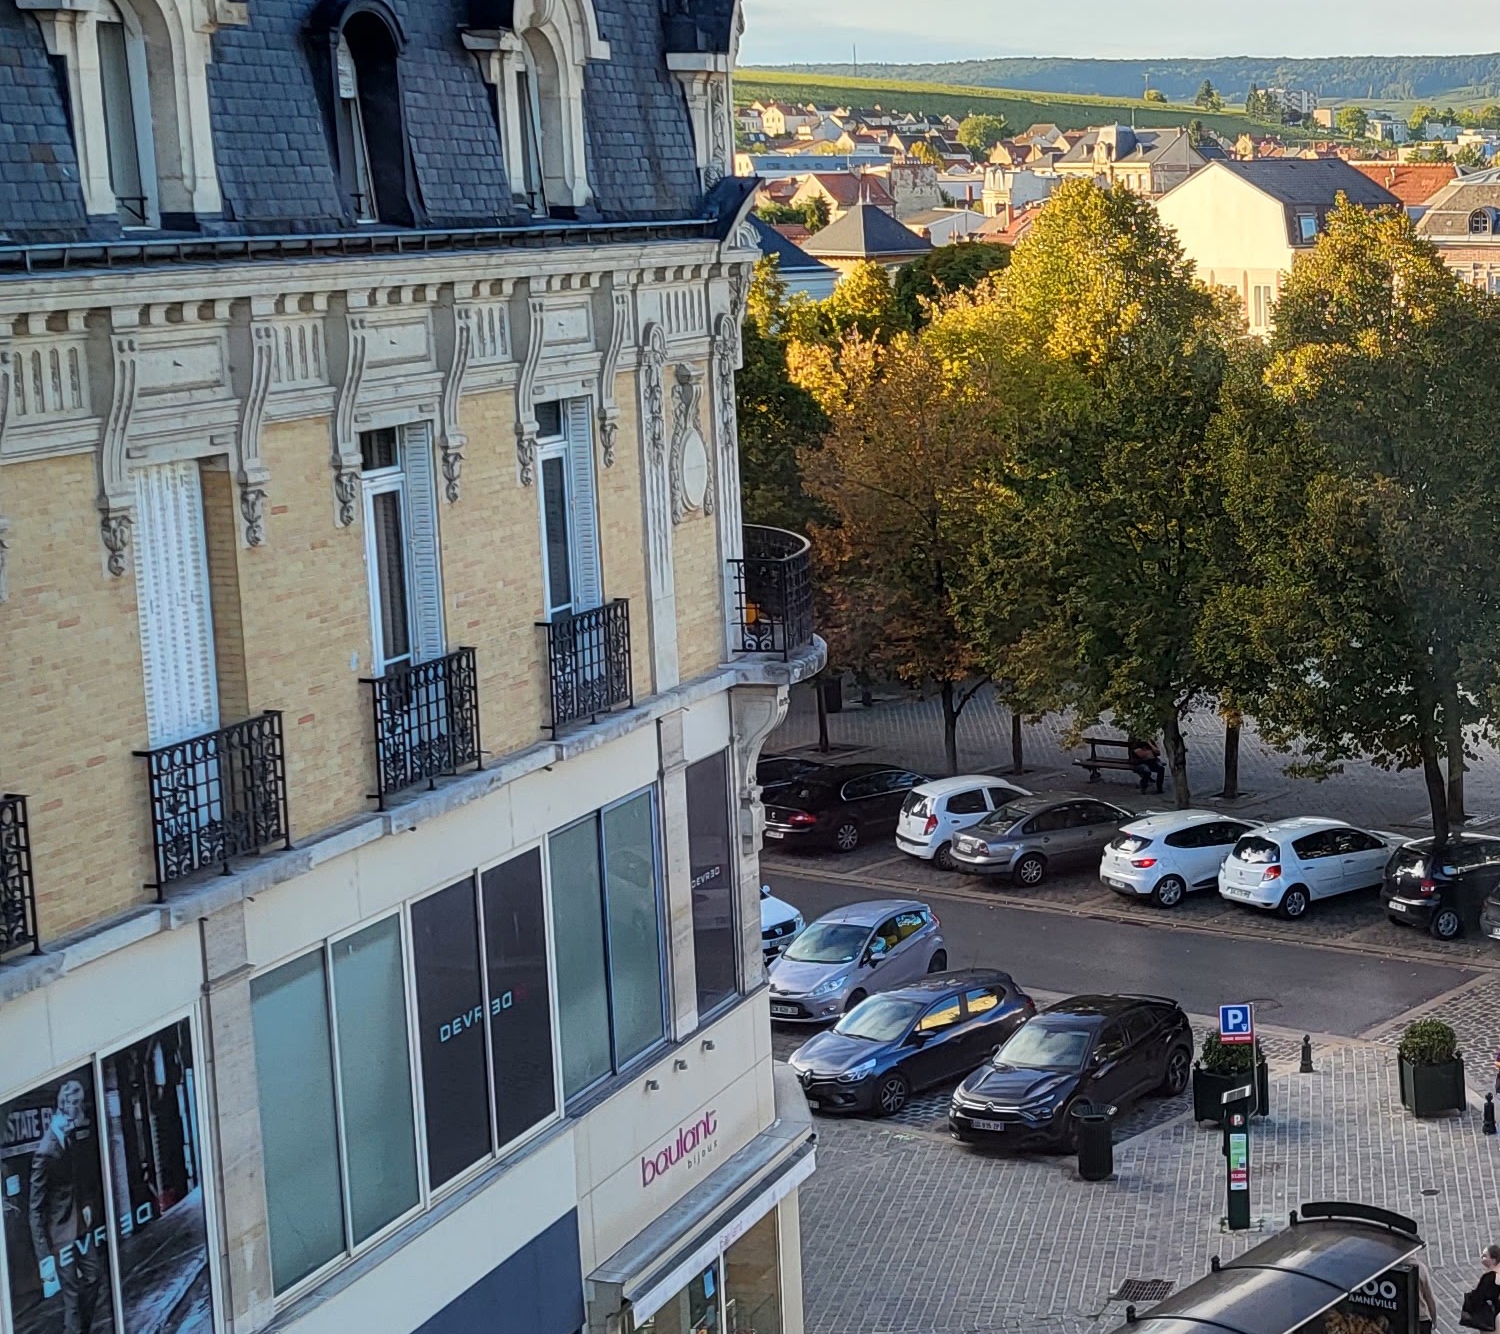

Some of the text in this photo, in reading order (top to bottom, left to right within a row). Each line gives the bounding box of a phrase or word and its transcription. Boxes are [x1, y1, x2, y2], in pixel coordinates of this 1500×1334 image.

[1227, 1010, 1243, 1030] P
[641, 1109, 718, 1188] baulant
[1353, 1280, 1397, 1299] OO
[1348, 1293, 1398, 1311] AMNÉVILLE
